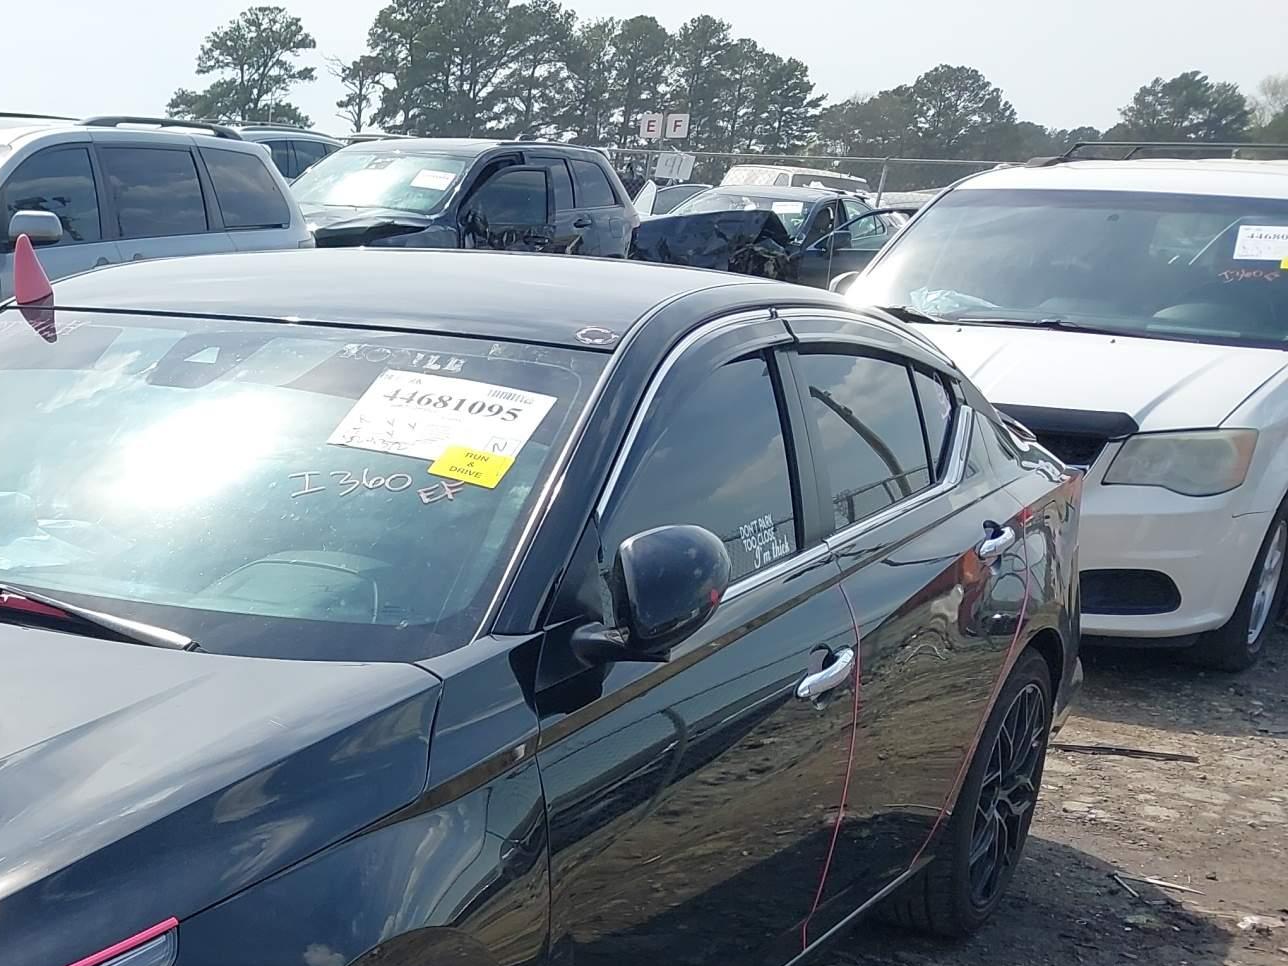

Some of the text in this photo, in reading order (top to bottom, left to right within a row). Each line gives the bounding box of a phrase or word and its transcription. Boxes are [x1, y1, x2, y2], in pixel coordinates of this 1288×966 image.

[647, 120, 657, 132] E
[673, 120, 683, 132] F
[383, 386, 524, 423] 44681095
[464, 452, 491, 463] RUN
[448, 466, 483, 480] DRIVE
[758, 513, 773, 529] PARK
[742, 527, 775, 553] TOO CLOSE
